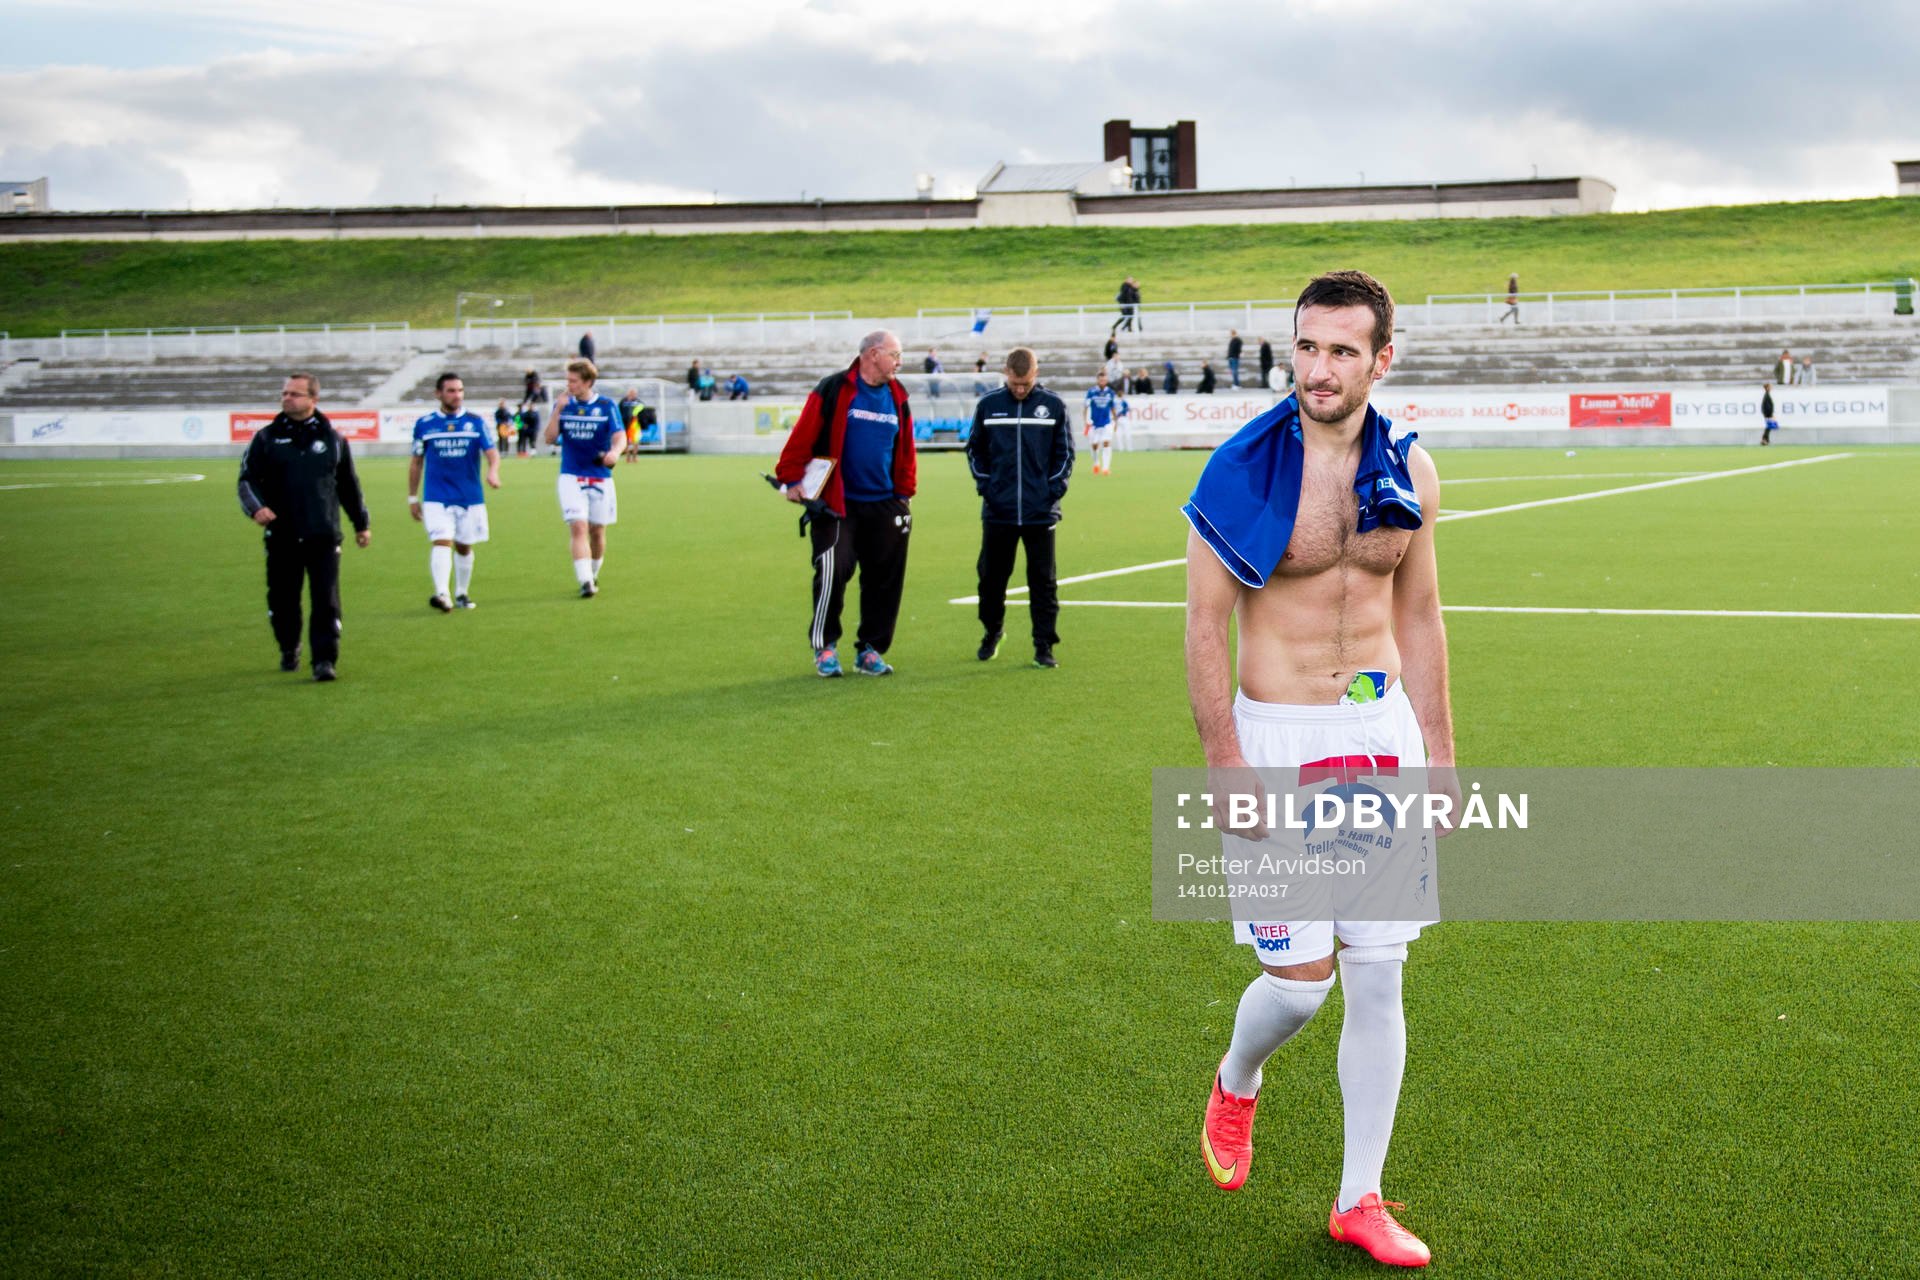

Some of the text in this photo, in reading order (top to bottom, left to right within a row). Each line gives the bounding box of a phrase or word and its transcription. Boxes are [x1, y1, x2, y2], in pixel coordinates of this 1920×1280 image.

[1129, 403, 1169, 420] ndic
[1185, 402, 1264, 420] Scandic
[1675, 403, 1757, 415] BYGGO
[1782, 401, 1885, 415] BYGGOM
[1375, 834, 1393, 849] AB
[1249, 922, 1289, 938] INTER
[1257, 937, 1291, 951] SPORT
